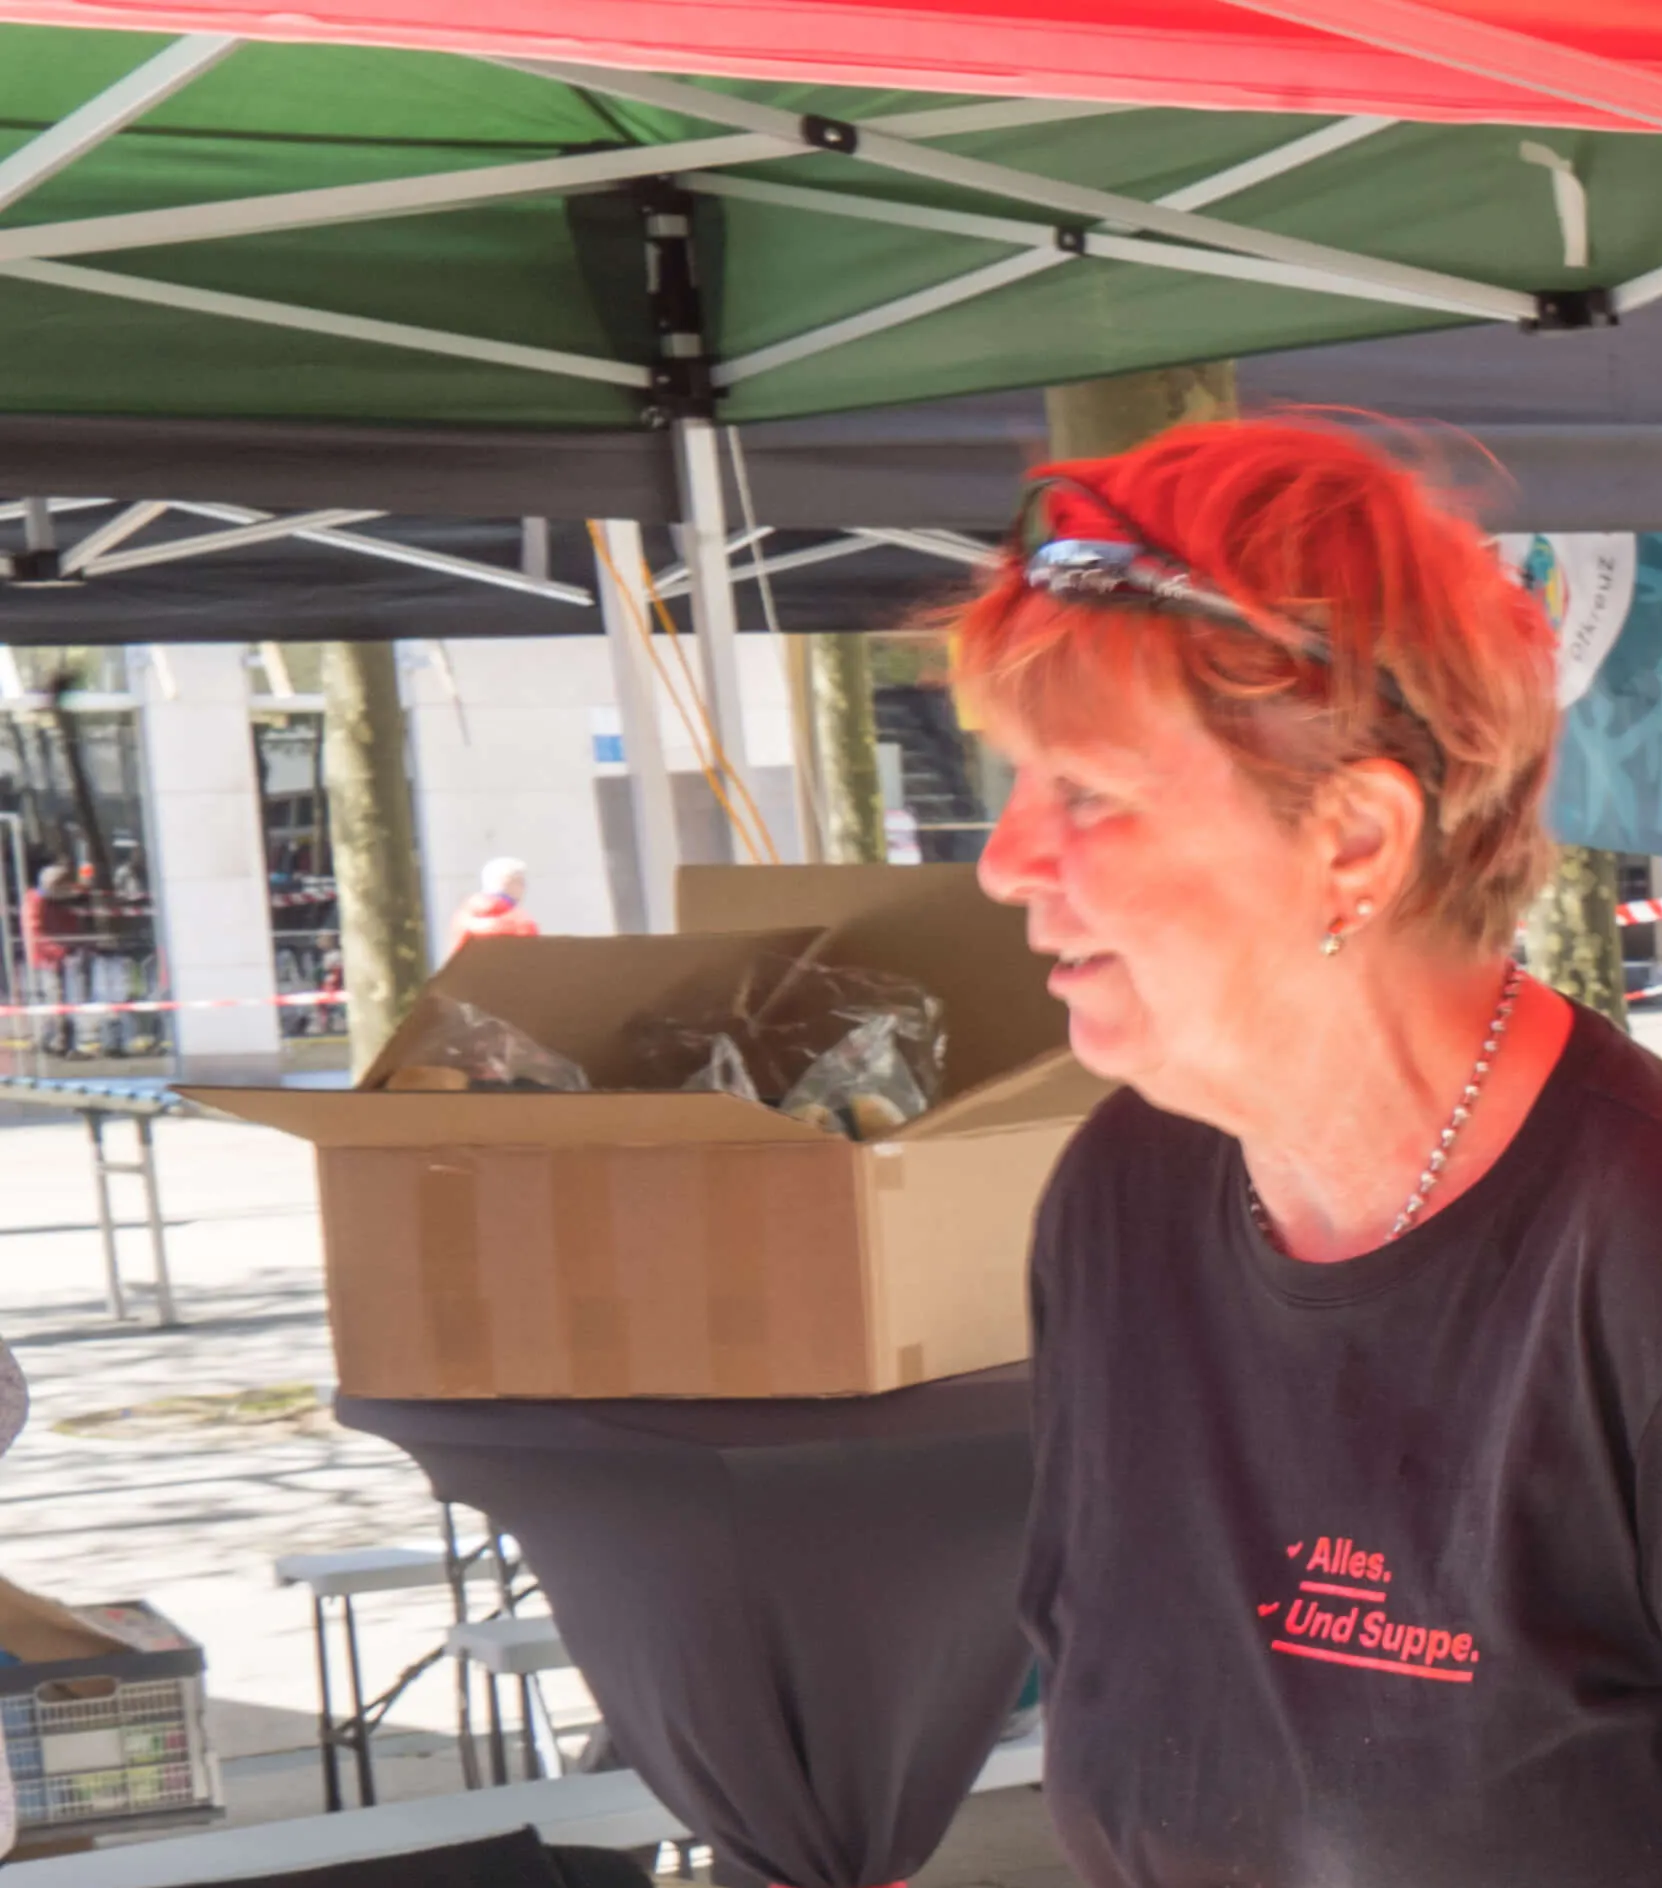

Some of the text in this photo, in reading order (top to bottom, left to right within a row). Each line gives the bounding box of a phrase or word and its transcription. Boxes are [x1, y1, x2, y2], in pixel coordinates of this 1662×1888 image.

[1306, 1536, 1392, 1583] Alles.
[1285, 1598, 1480, 1665] Und Suppe.
